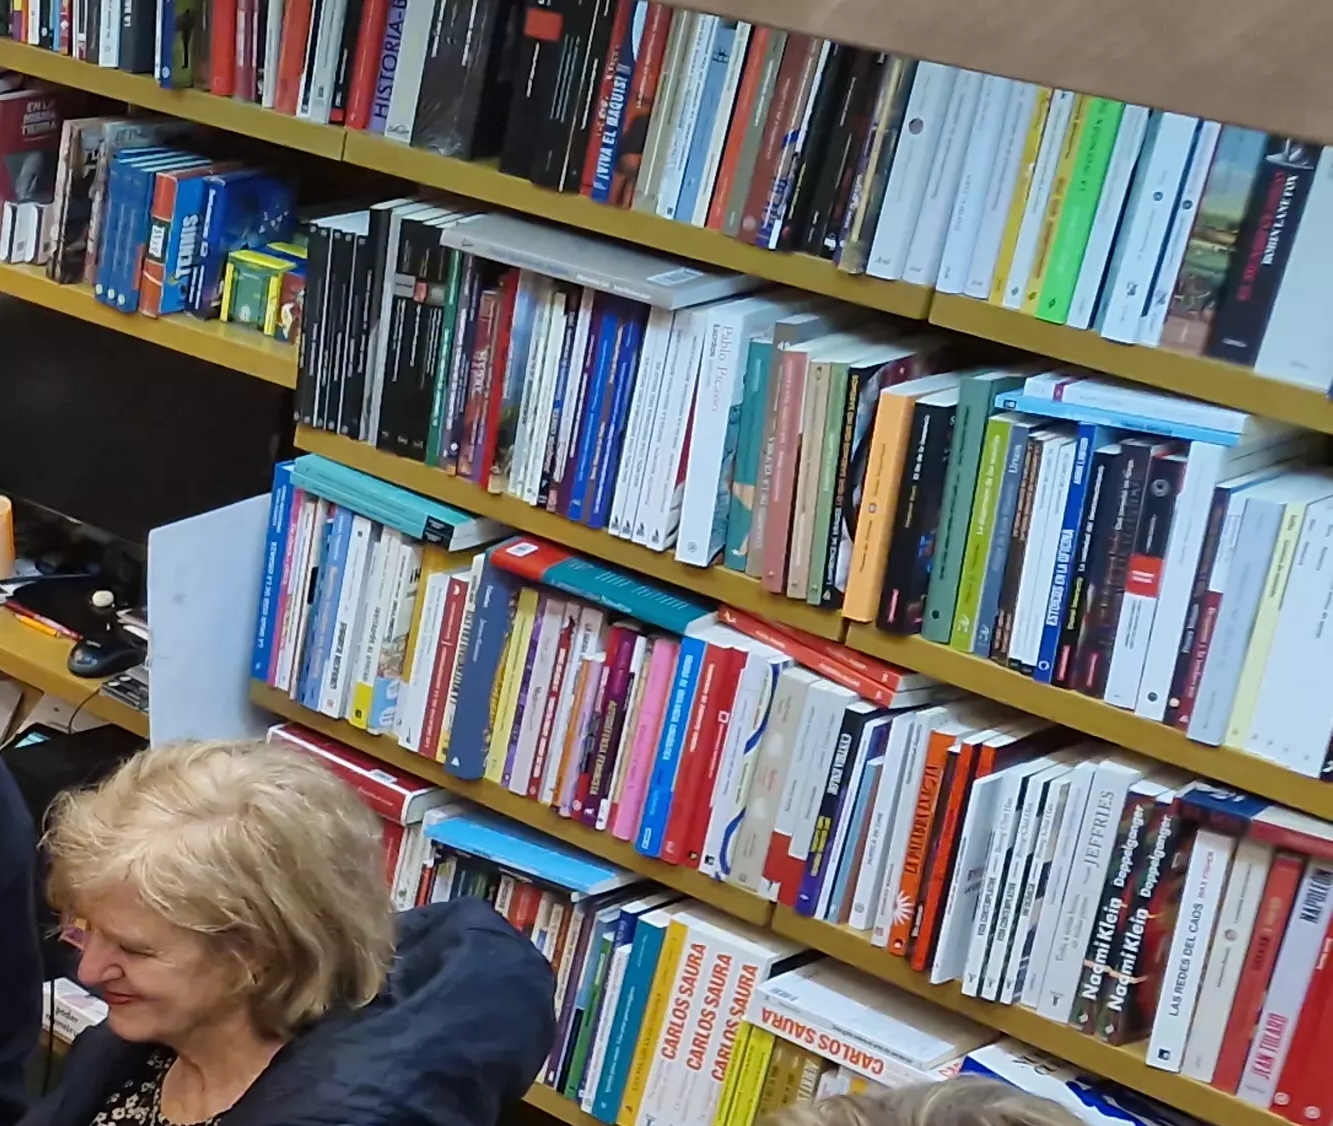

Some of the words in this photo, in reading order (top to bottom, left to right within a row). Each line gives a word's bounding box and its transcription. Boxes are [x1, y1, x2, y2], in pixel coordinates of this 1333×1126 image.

[602, 129, 617, 147] EL
[175, 213, 200, 280] TENNIS
[718, 325, 734, 361] Pablo
[711, 366, 728, 412] Picasso
[1083, 790, 1115, 869] JEFFRIES
[1082, 949, 1110, 1000] Naomi
[1097, 897, 1123, 947] Klein
[1113, 803, 1146, 889] Doppelganger
[1106, 957, 1137, 1012] Naomi
[1123, 907, 1150, 956] Klein
[1139, 814, 1173, 899] Doppelganger
[1188, 902, 1205, 935] CAOS
[1183, 936, 1197, 958] DEL
[729, 963, 759, 1020] SAURA
[1174, 957, 1192, 997] REDES
[661, 997, 691, 1061] CARLOS
[679, 942, 707, 998] SAURA
[686, 1008, 717, 1072] CARLOS
[704, 953, 733, 1009] SAURA
[1168, 997, 1182, 1017] LAS
[761, 1006, 818, 1045] SAURA
[817, 1035, 886, 1076] CARLOS
[1252, 1051, 1276, 1081] JEAN
